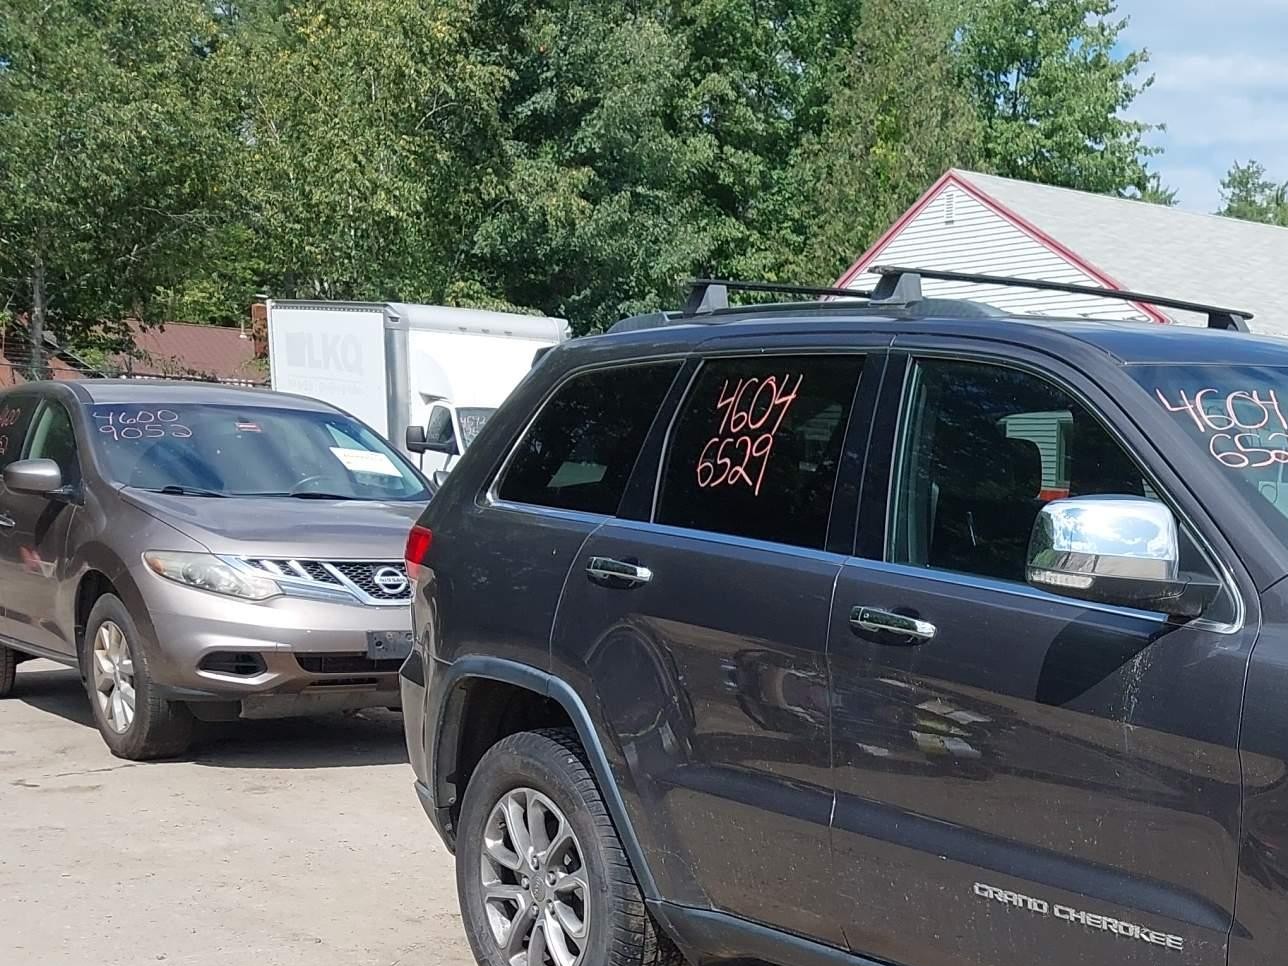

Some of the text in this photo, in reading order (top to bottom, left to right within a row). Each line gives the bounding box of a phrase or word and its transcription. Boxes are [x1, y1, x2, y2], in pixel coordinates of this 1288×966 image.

[306, 332, 363, 374] LKQ
[92, 409, 179, 425] 4600
[717, 374, 803, 434] 4604
[1156, 388, 1288, 432] 4604
[99, 424, 193, 440] 9052
[696, 434, 773, 496] 6529
[973, 882, 1185, 950] GRAND CHEROKEE
